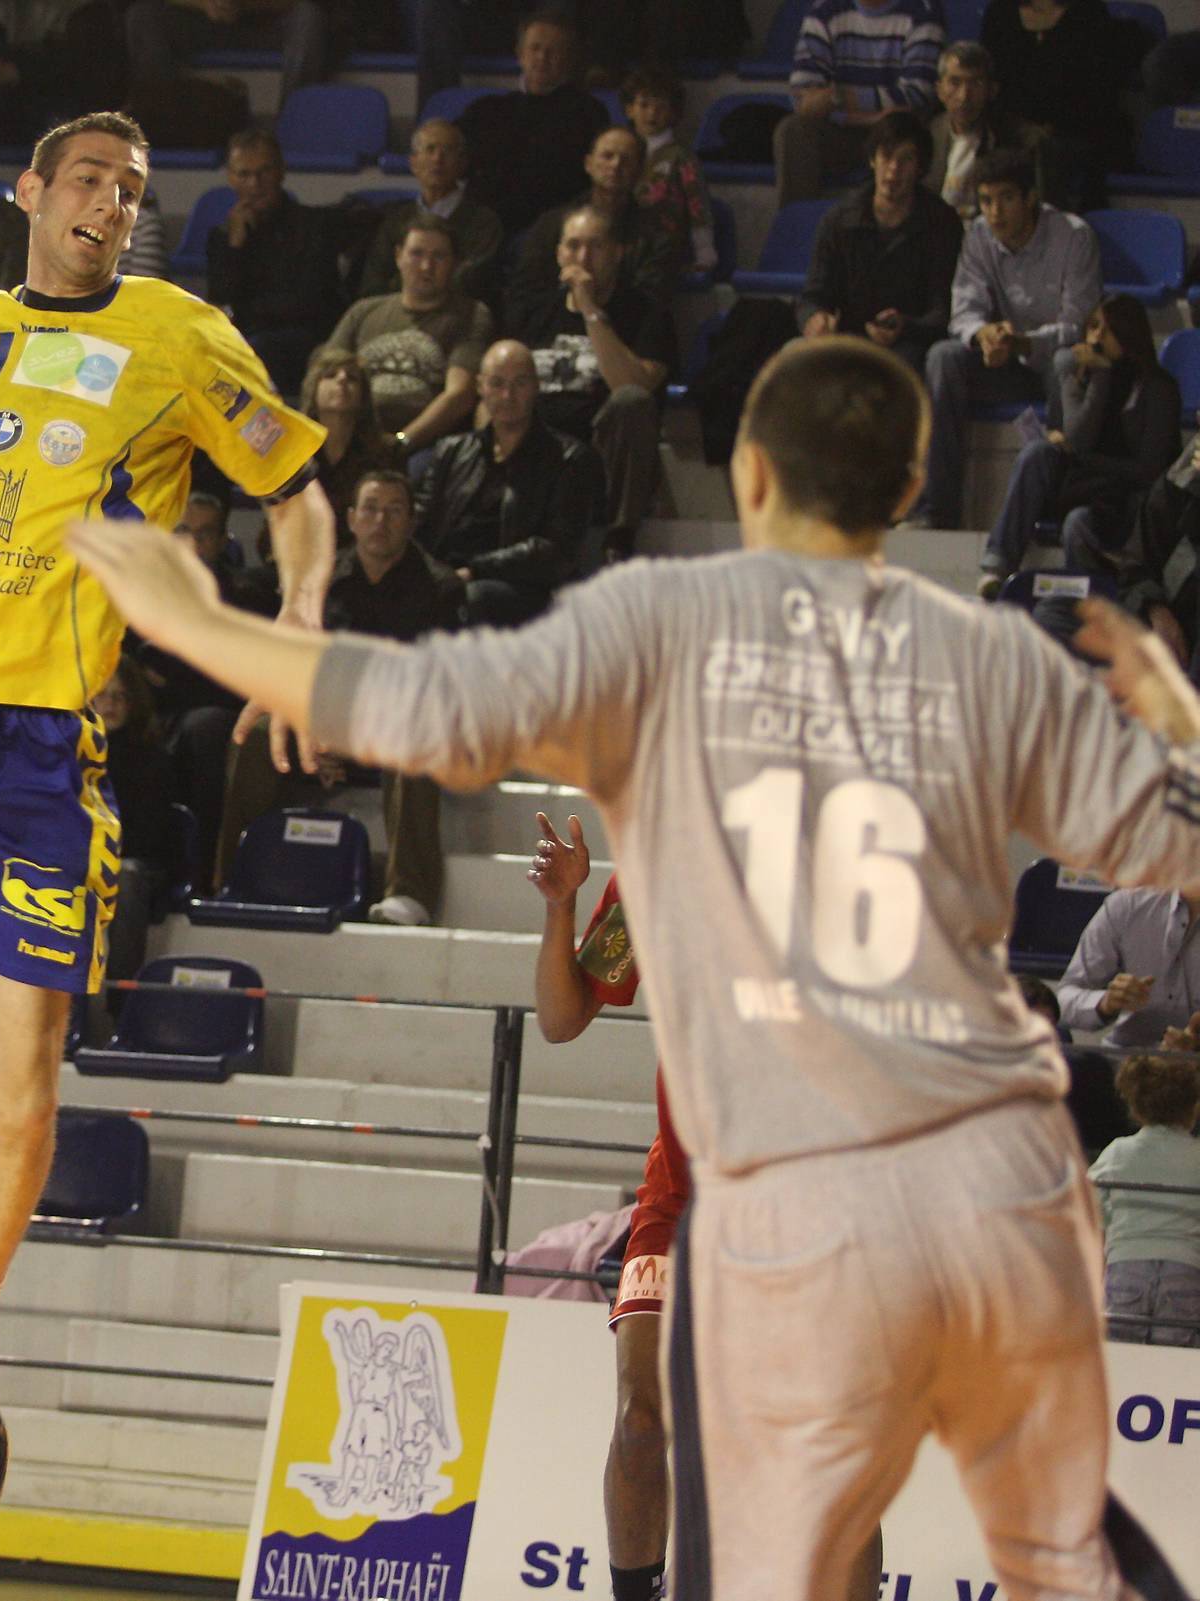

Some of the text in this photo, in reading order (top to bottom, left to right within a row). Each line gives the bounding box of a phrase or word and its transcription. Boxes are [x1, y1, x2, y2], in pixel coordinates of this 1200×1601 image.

[722, 766, 927, 990] 16
[1117, 1394, 1200, 1444] OF
[261, 1549, 452, 1601] SAINT-RAPHAËL
[520, 1541, 589, 1591] St
